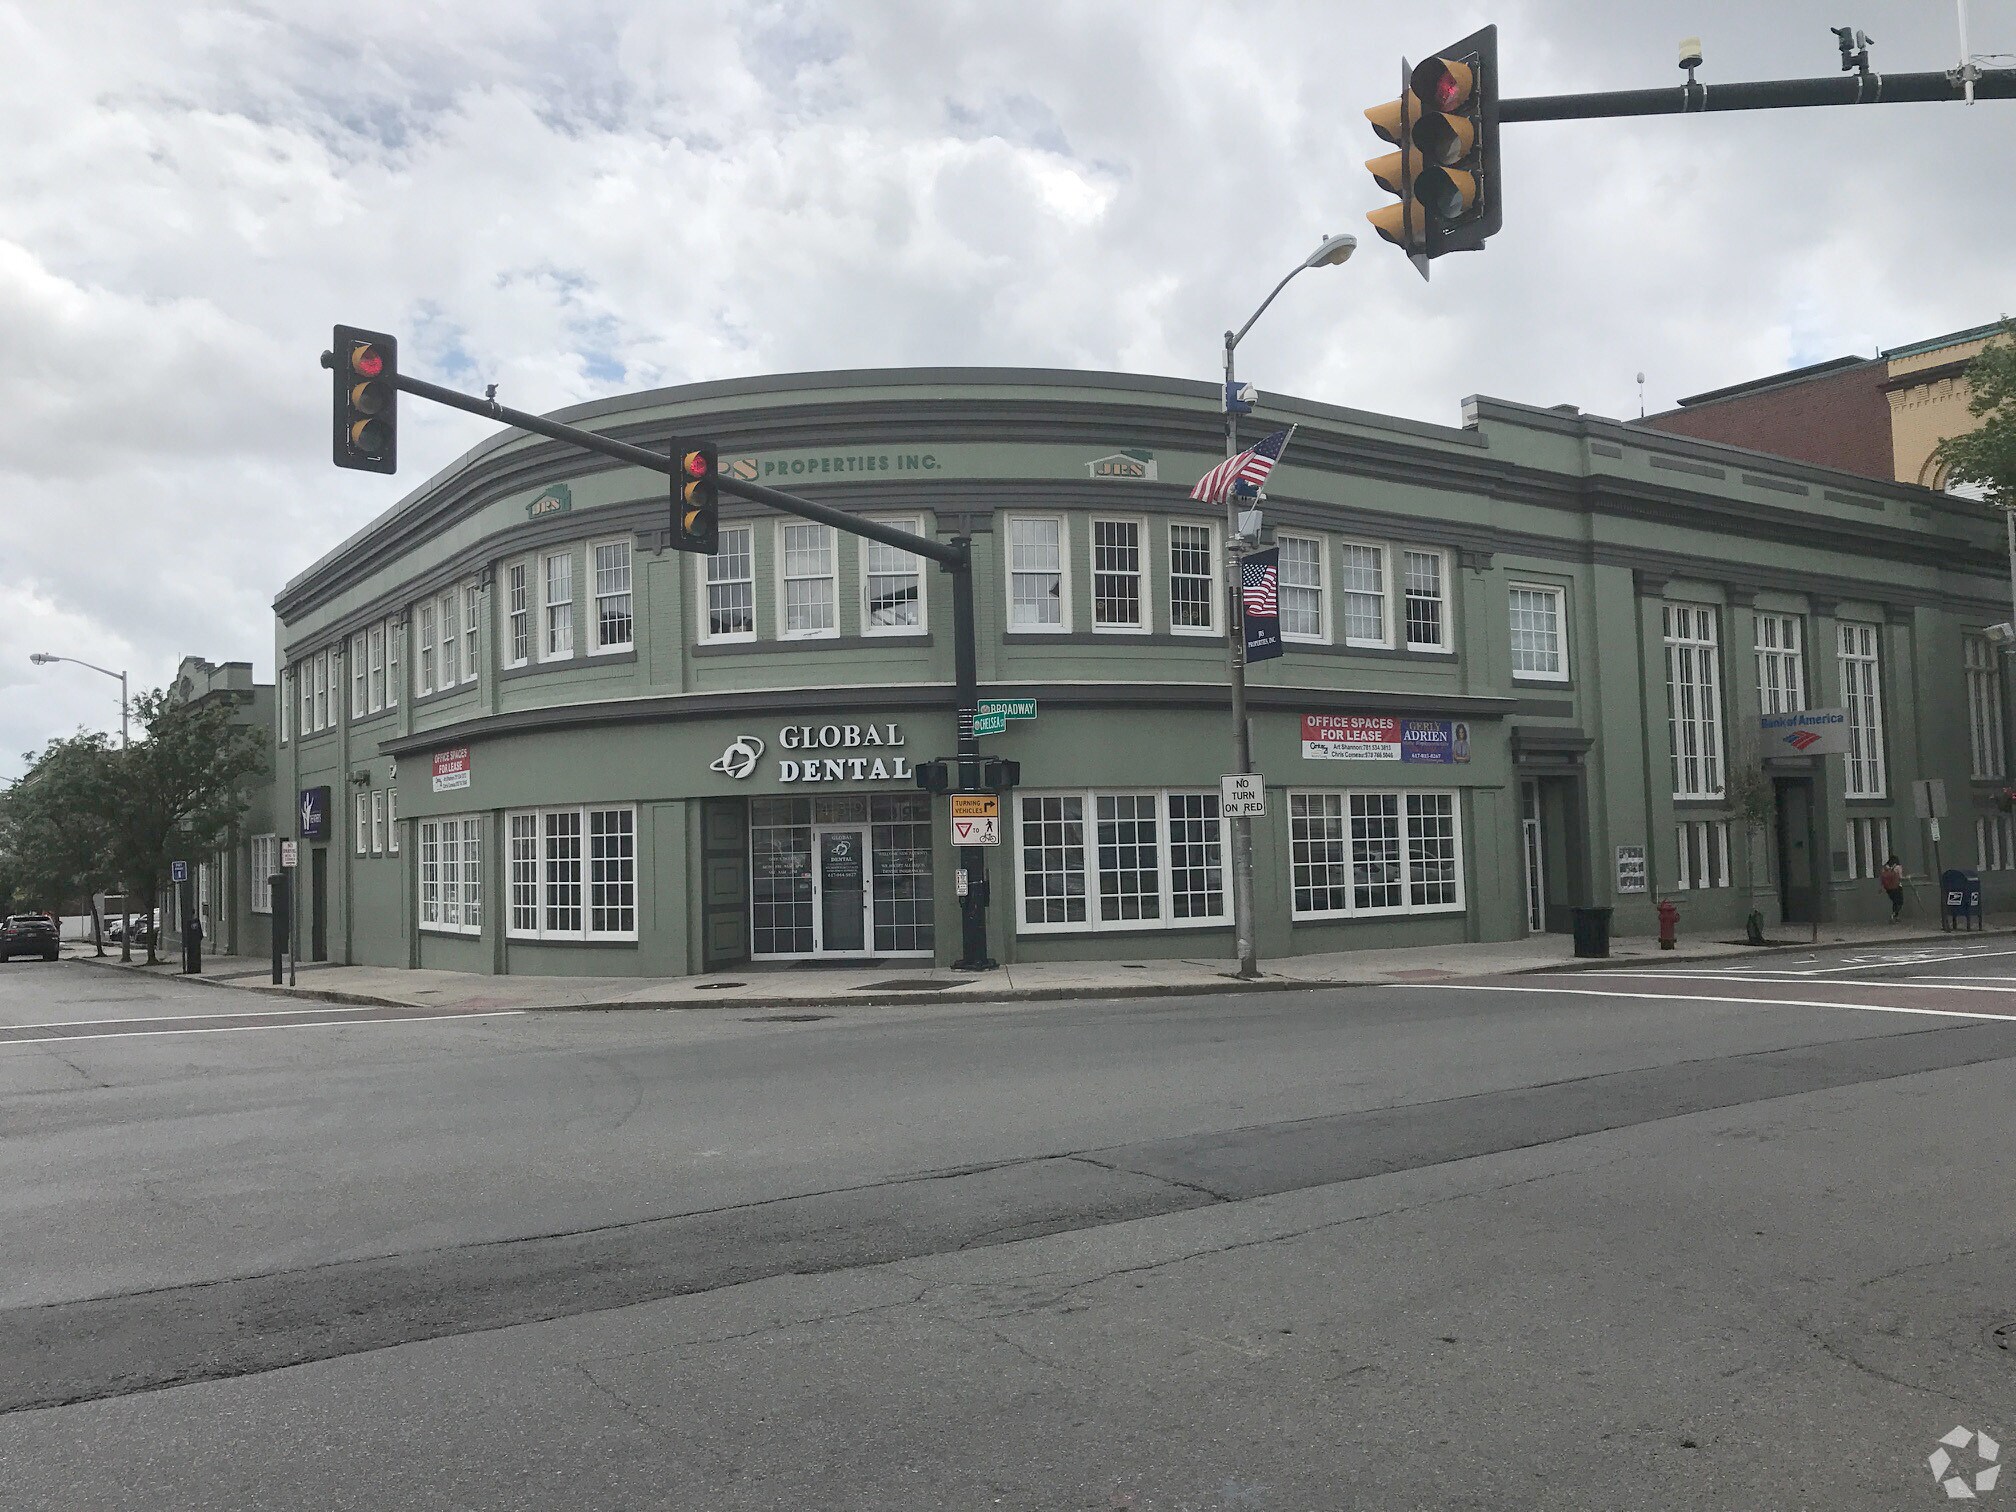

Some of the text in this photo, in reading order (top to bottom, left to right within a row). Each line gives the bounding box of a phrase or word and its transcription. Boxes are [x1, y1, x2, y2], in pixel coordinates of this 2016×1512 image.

[765, 455, 889, 476] PROPERTIES
[897, 454, 942, 470] INC.
[1096, 463, 1144, 477] JRS
[990, 703, 1034, 715] BROADWAY
[980, 716, 1000, 730] CHELSEA
[1307, 716, 1394, 729] OFFICE SPACES
[1761, 713, 1844, 728] Bank of America
[779, 723, 905, 749] GLOBAL
[1320, 729, 1382, 741] FOR LEASE
[1403, 730, 1448, 741] ADRIEN
[434, 752, 449, 763] OFFICE
[439, 760, 462, 774] FOR LEASE
[778, 757, 912, 782] DENTAL
[1236, 778, 1249, 788] NO
[1232, 791, 1255, 800] TURN
[1225, 803, 1263, 812] ON RED
